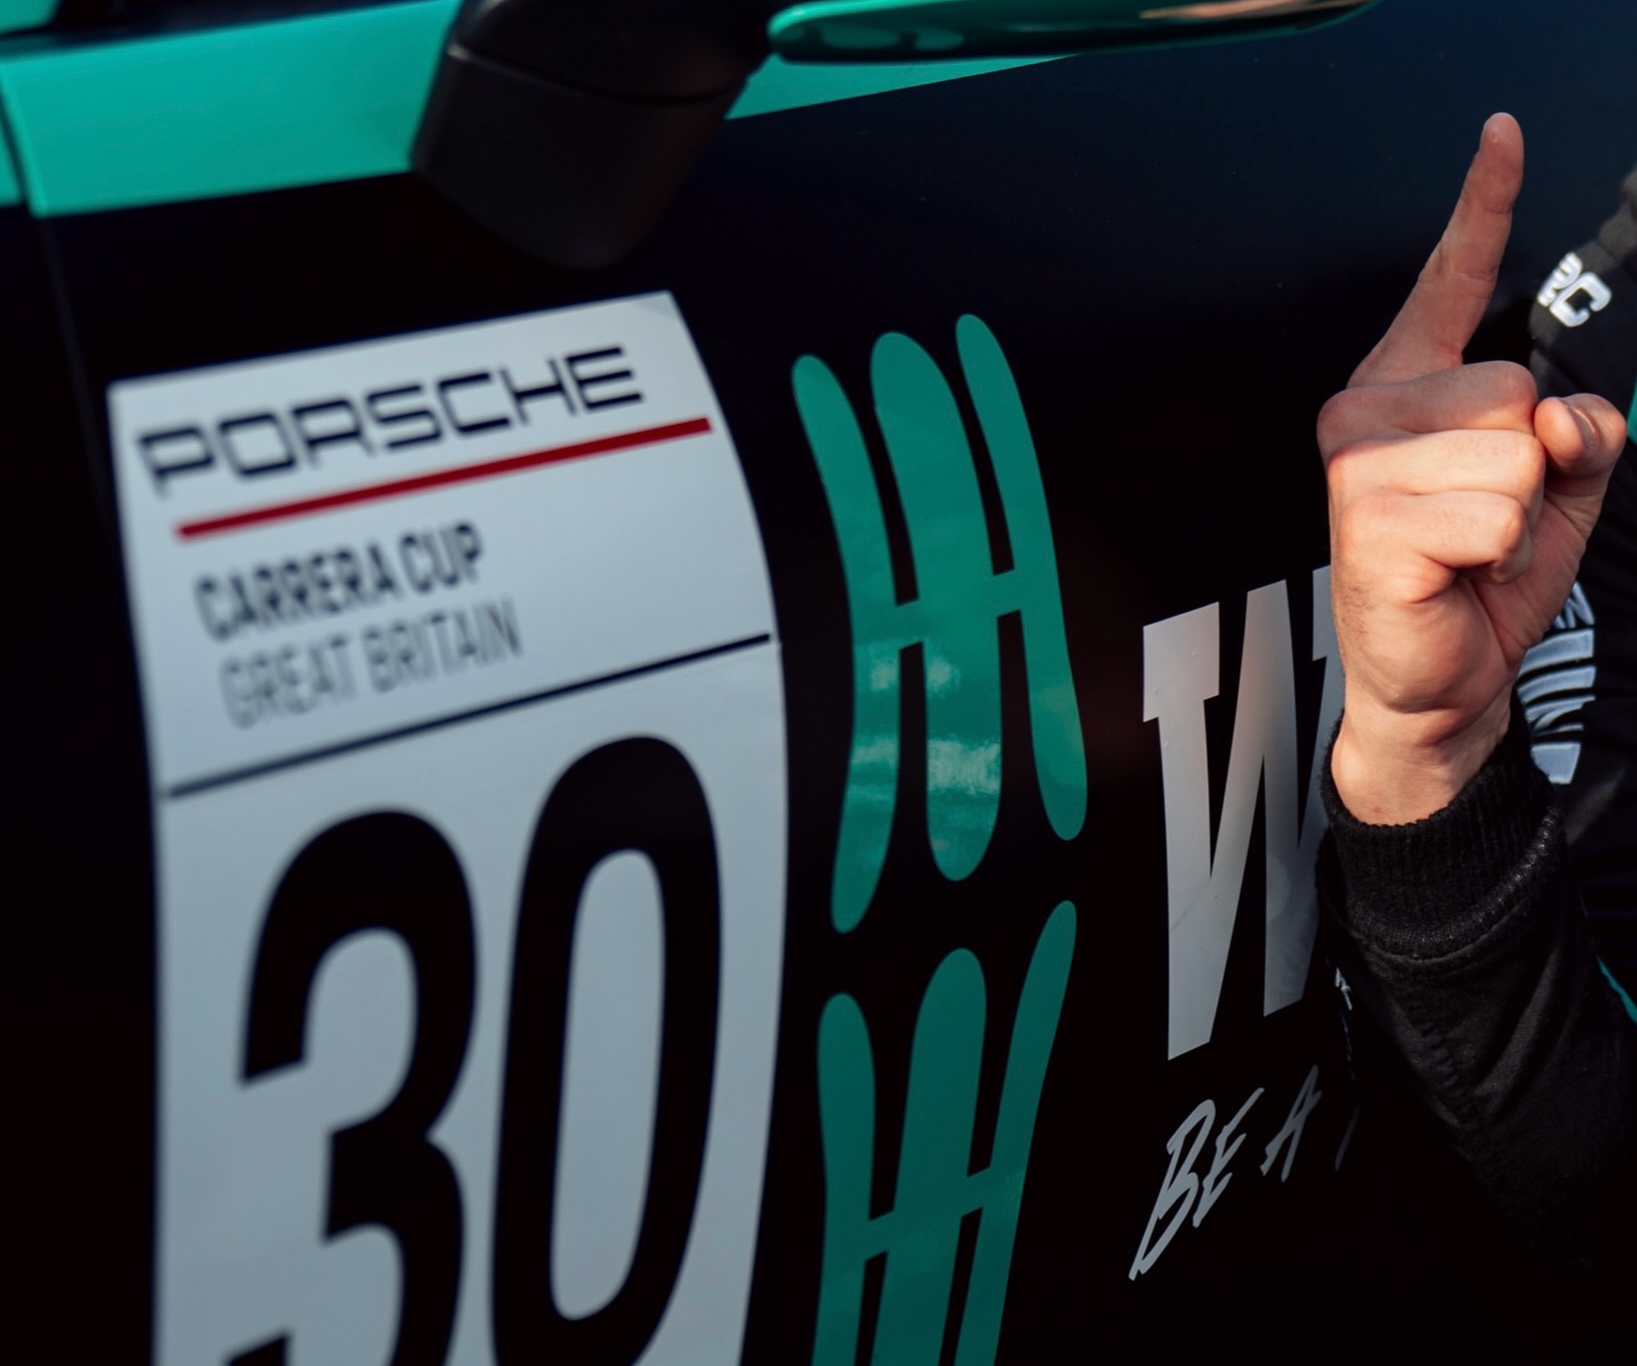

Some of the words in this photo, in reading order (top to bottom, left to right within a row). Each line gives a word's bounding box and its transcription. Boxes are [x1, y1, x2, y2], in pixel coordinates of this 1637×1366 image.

[135, 346, 644, 497] PORSCHE
[192, 541, 398, 642] CARRERA
[397, 521, 484, 595] CUP
[217, 632, 358, 730] GREAT
[361, 596, 524, 695] BRITAIN
[1128, 1087, 1264, 1281] BE
[1260, 1065, 1322, 1182] A
